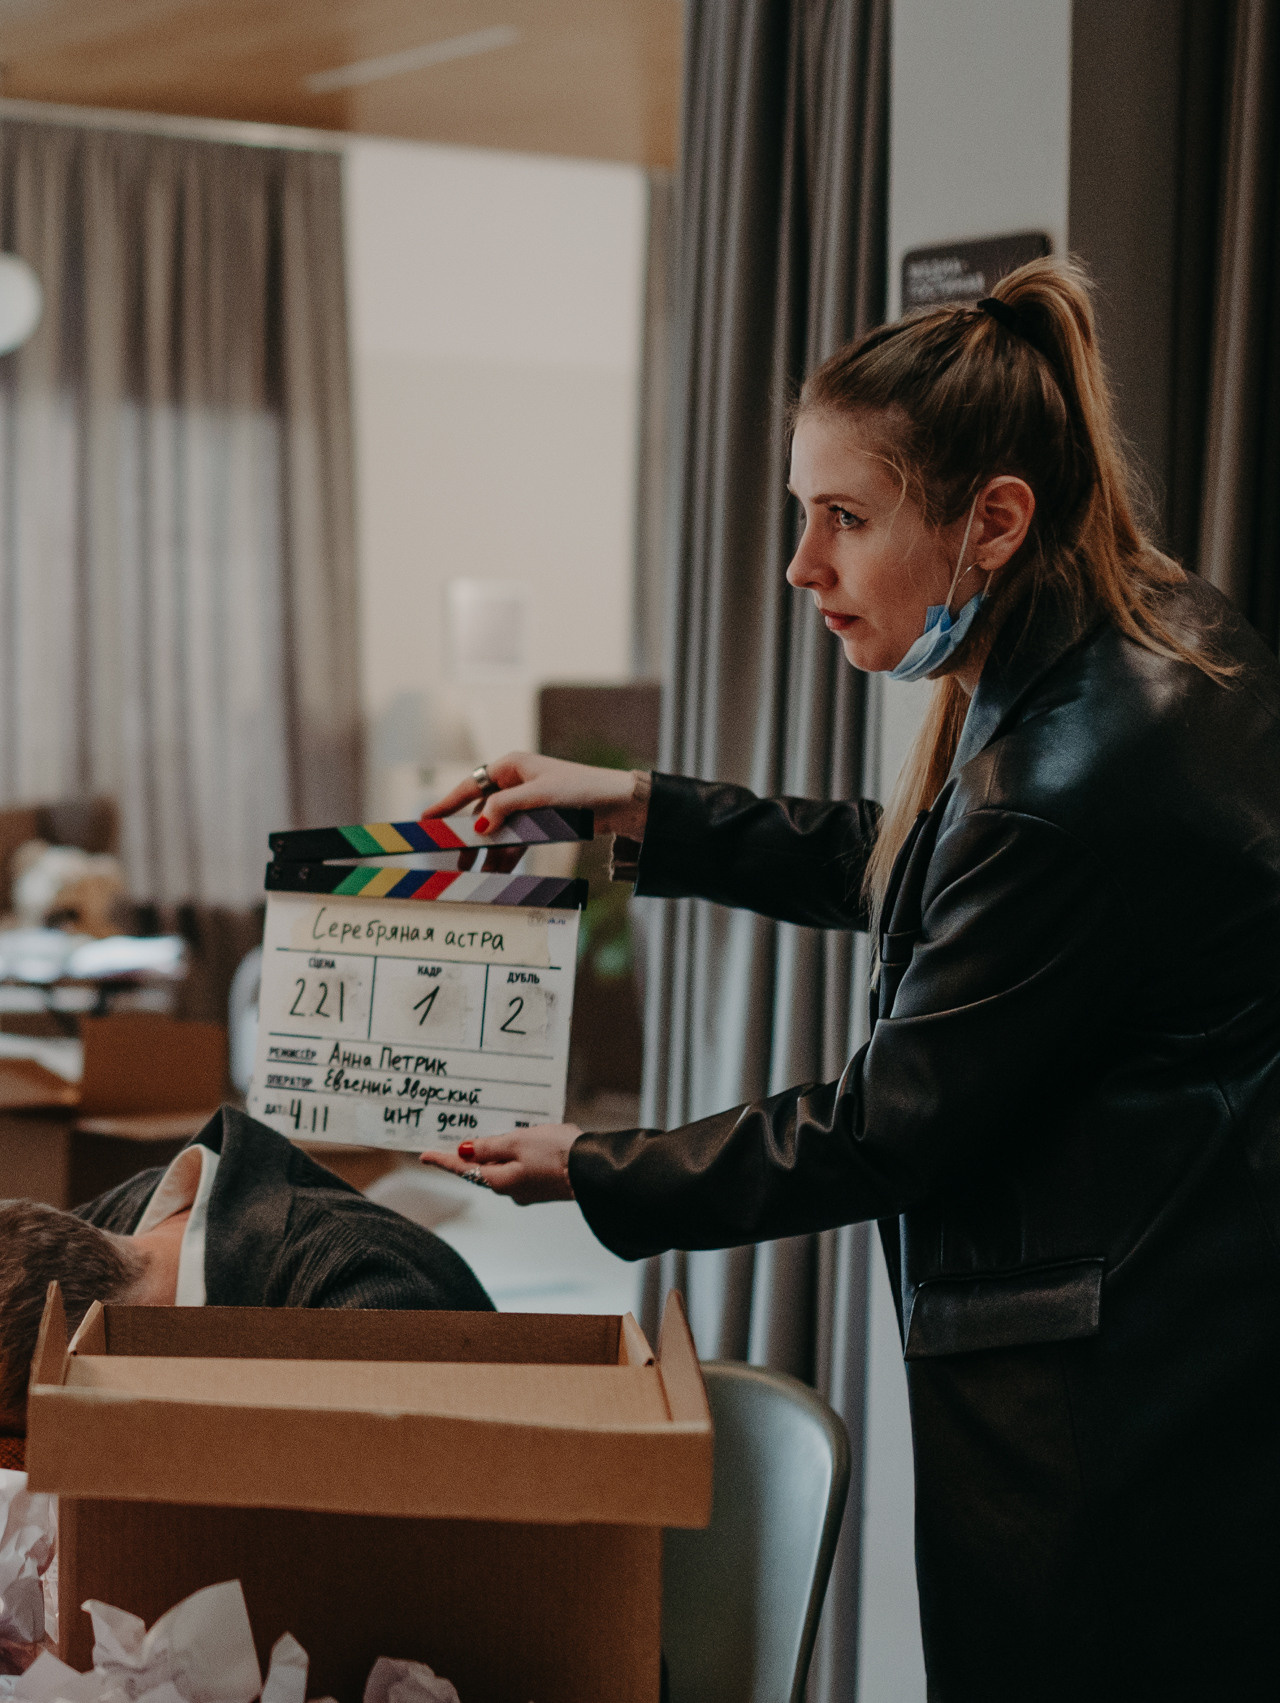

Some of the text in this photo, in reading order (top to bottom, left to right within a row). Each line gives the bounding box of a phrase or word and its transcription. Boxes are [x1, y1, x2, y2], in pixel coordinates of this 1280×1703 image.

[312, 907, 505, 951] Серебряная астра
[308, 958, 336, 969] СЦЕНА
[417, 965, 442, 977] КАДР
[507, 972, 540, 984] ДУБЛЬ
[413, 985, 440, 1026] 1
[500, 996, 526, 1035] 2
[328, 1042, 448, 1076] Анна Петрик
[324, 1068, 482, 1106] Евгений Яворский
[264, 1103, 287, 1115] ДАТ
[437, 1112, 478, 1132] день
